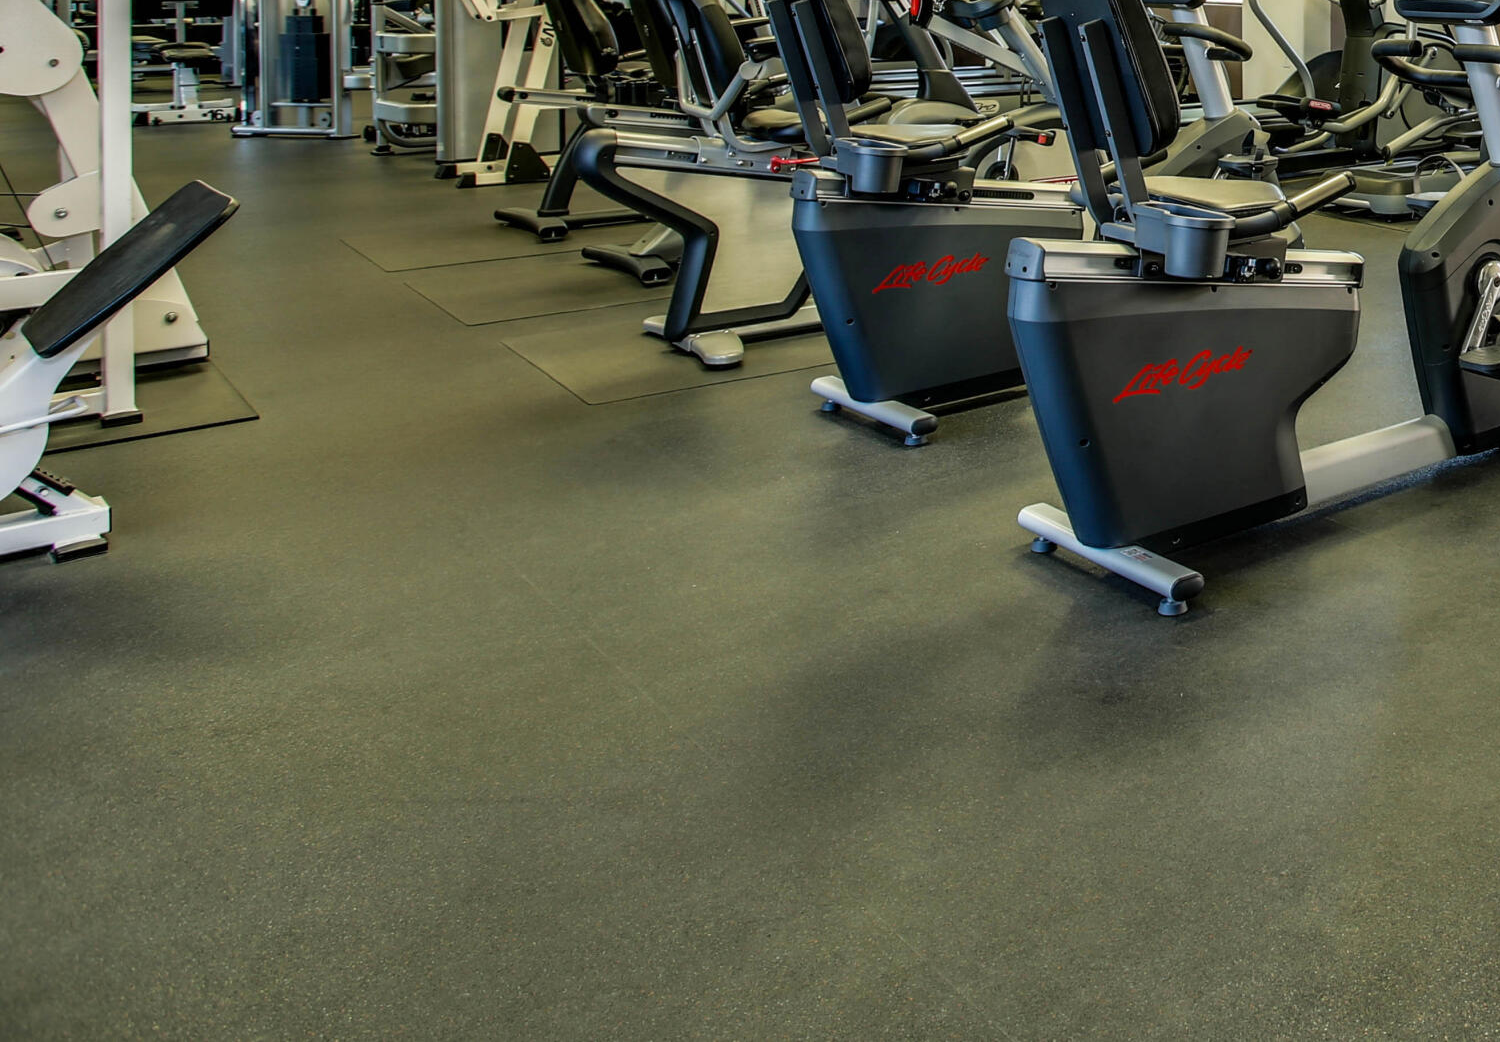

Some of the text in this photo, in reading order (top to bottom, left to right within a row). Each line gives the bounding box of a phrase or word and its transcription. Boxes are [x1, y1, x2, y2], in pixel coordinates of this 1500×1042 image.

[926, 251, 991, 286] Cycle
[1112, 345, 1253, 404] Life Cycle
